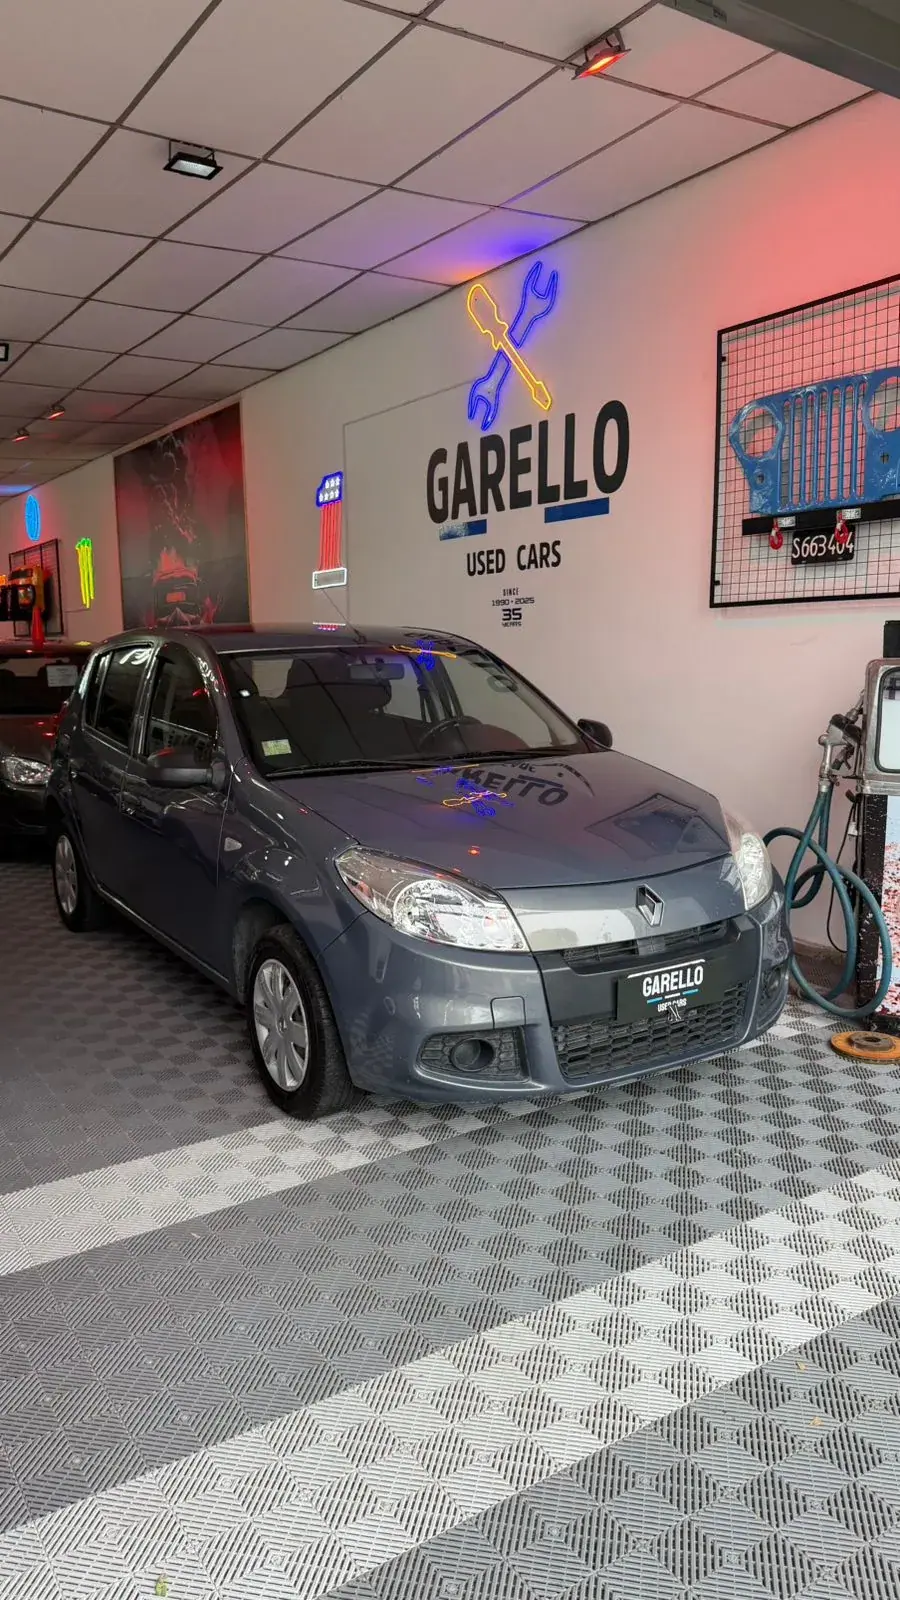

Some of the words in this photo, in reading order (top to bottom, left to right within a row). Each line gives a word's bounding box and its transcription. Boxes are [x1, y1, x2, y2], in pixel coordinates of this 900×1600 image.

[426, 400, 630, 524] GARELLO
[466, 548, 506, 577] USED
[516, 540, 562, 571] CARS
[491, 598, 510, 607] 1990
[514, 597, 535, 605] 2025
[503, 587, 520, 597] SINCE
[501, 607, 522, 622] 35
[642, 965, 704, 997] GARELLO
